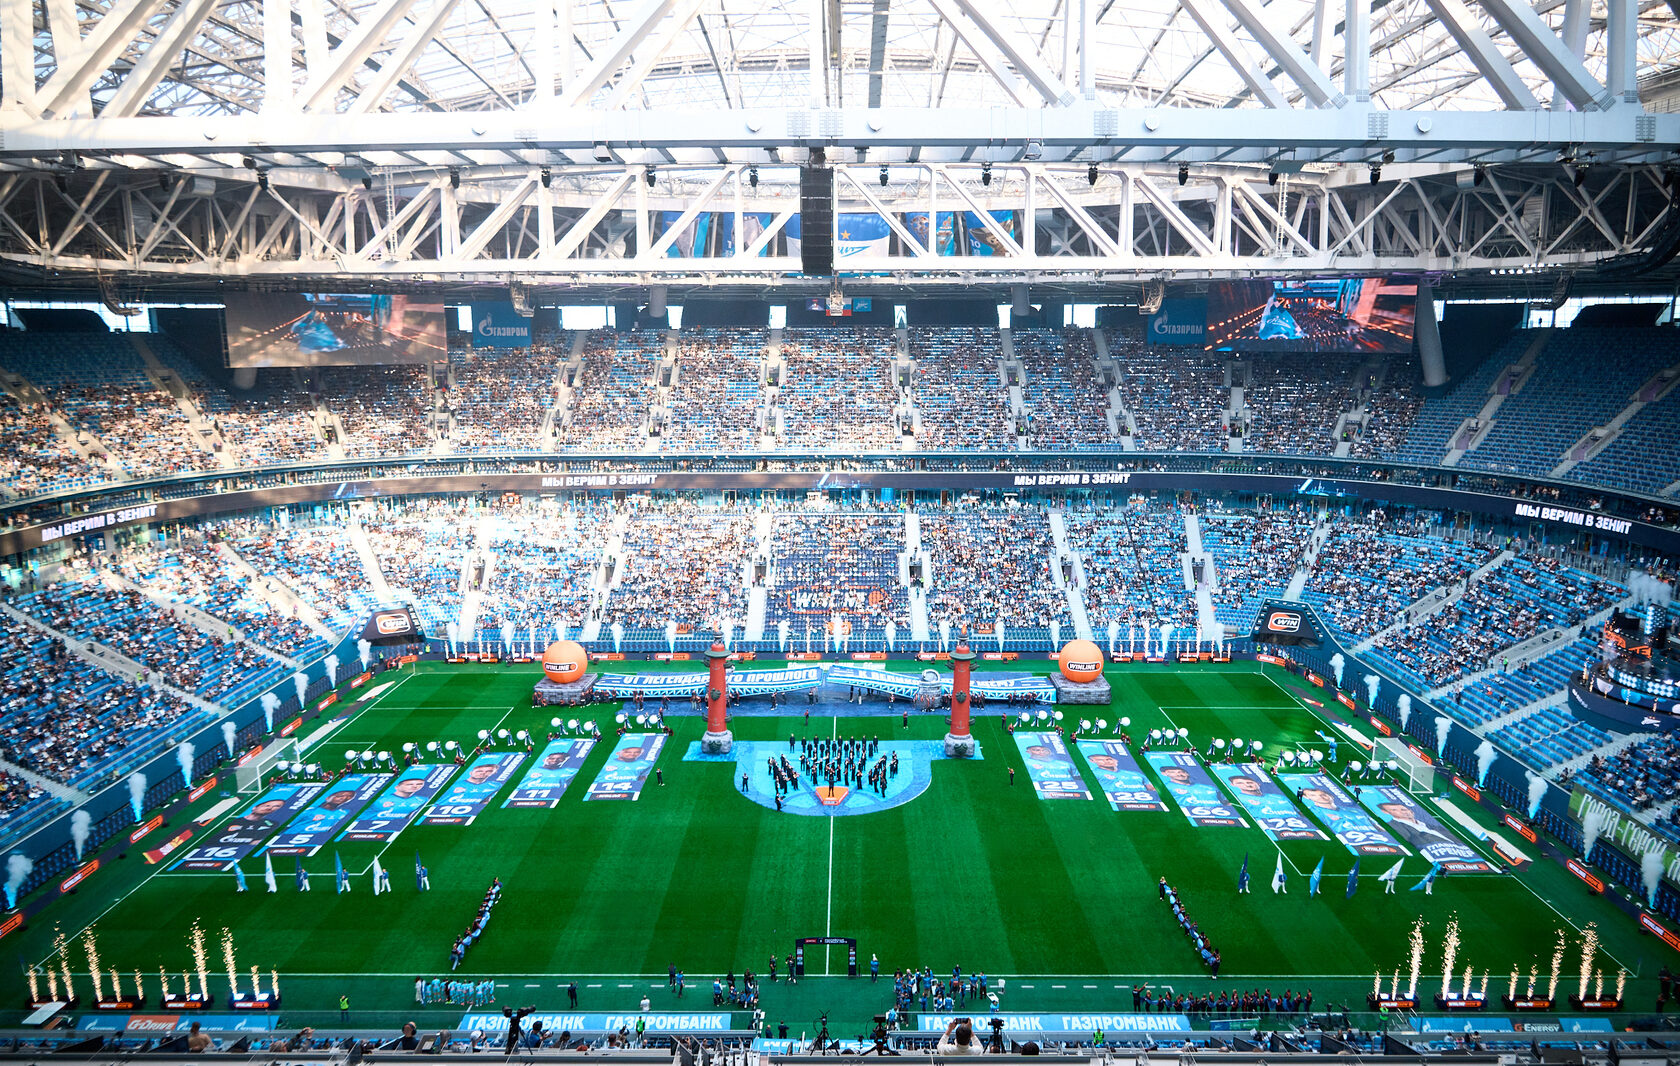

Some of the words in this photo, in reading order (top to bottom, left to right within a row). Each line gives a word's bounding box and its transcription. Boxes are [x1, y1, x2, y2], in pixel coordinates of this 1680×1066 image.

[541, 477, 564, 487] МЫ
[565, 475, 608, 486] ВЕРИМ
[608, 475, 618, 485] В
[618, 474, 658, 485] ЗЕНИТ
[1013, 475, 1037, 486] МЫ
[1038, 474, 1081, 485] ВЕРИМ
[1081, 474, 1090, 484] В
[1091, 473, 1131, 484] ЗЕНИТ
[41, 525, 63, 542] МЫ
[63, 515, 106, 536] ВЕРИМ
[106, 513, 117, 526] В
[117, 505, 158, 523] ЗЕНИТ
[1515, 503, 1540, 518] МЫ
[1541, 507, 1584, 525] ВЕРИМ
[1585, 514, 1594, 527] В
[1595, 516, 1633, 535] ЗЕНИТ
[1277, 618, 1298, 627] WIN
[545, 663, 570, 671] WINLINE
[1069, 662, 1096, 671] WINLINE
[747, 668, 818, 683] ПРОШЛОГО
[601, 782, 633, 791] 14
[1042, 781, 1079, 790] 25
[525, 789, 551, 798] 11
[1114, 792, 1154, 801] 28
[439, 805, 473, 815] 10
[1191, 807, 1231, 816] 66
[368, 820, 391, 830] 7
[1267, 817, 1308, 828] 78
[288, 834, 315, 844] 5
[203, 846, 240, 858] 16
[1431, 847, 1475, 858] ТРЕНЕР
[1062, 1016, 1182, 1031] ГАЗПРОМБАНК
